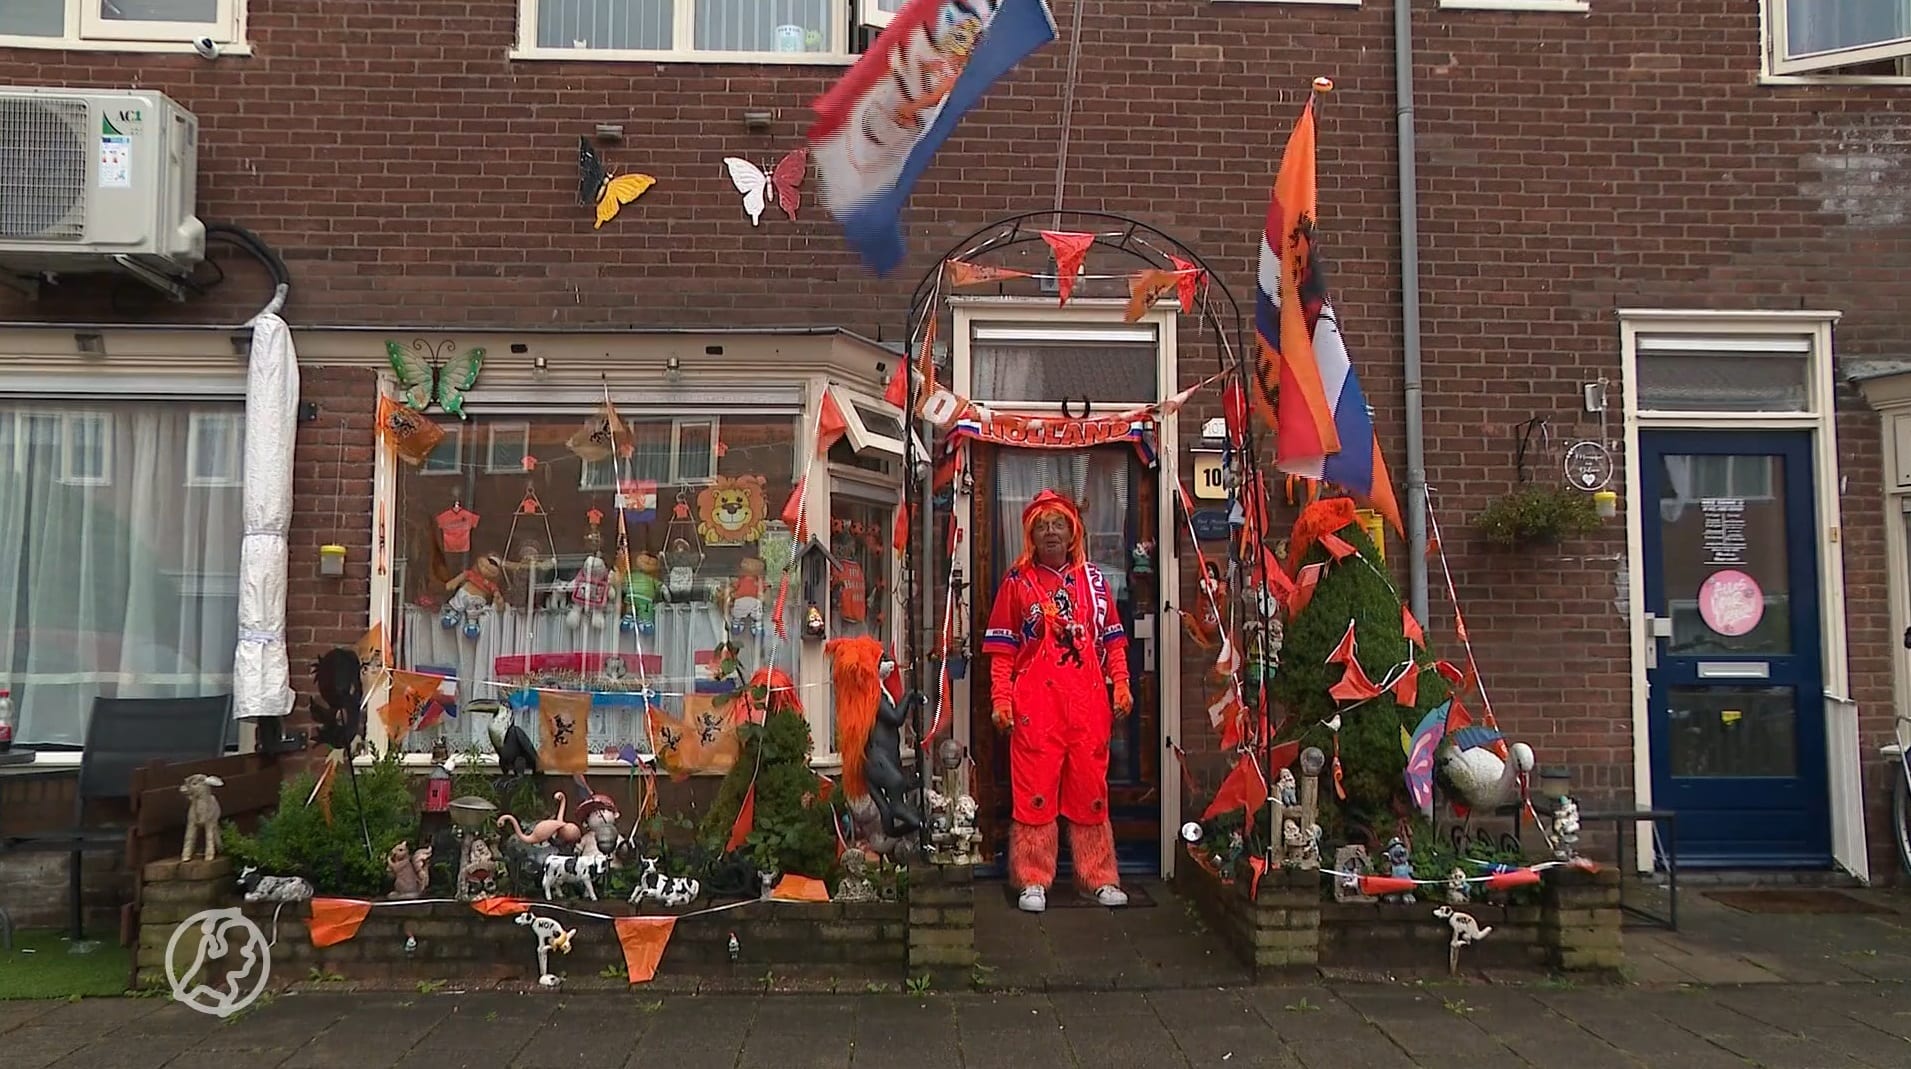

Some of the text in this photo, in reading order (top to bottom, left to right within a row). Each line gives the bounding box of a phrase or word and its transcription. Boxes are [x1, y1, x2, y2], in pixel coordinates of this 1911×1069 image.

[980, 419, 1131, 446] HOLLAND
[1203, 467, 1222, 487] 10
[538, 921, 555, 930] NO!
